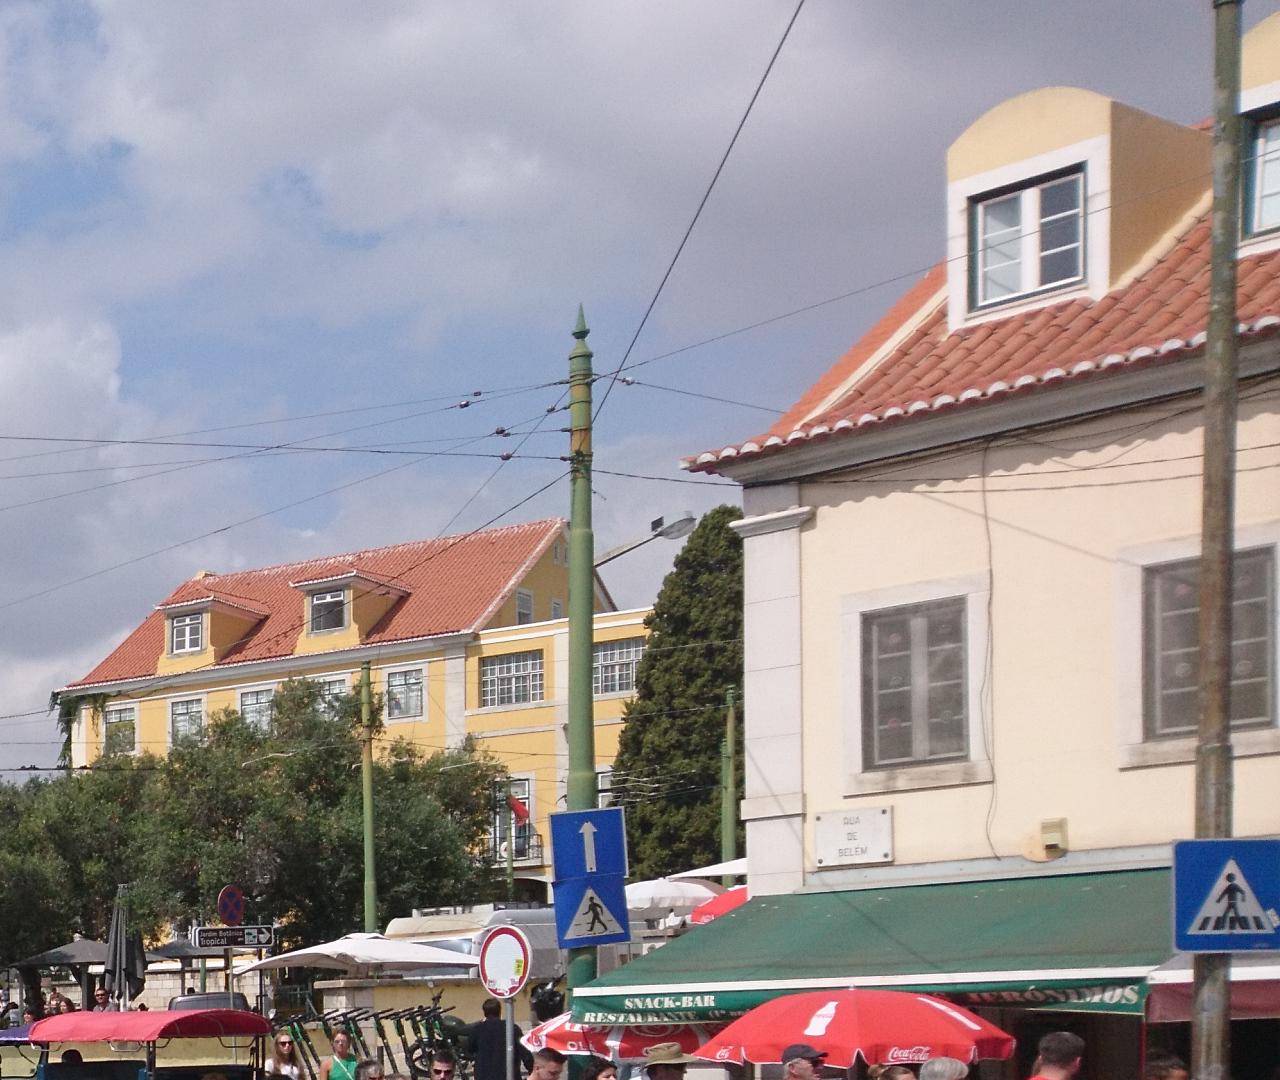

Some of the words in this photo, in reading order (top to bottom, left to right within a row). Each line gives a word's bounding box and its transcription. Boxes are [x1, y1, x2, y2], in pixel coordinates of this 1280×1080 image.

[200, 937, 228, 946] Tropical
[624, 995, 716, 1010] SNACK-BAR
[584, 1011, 697, 1024] RESTAURANTE
